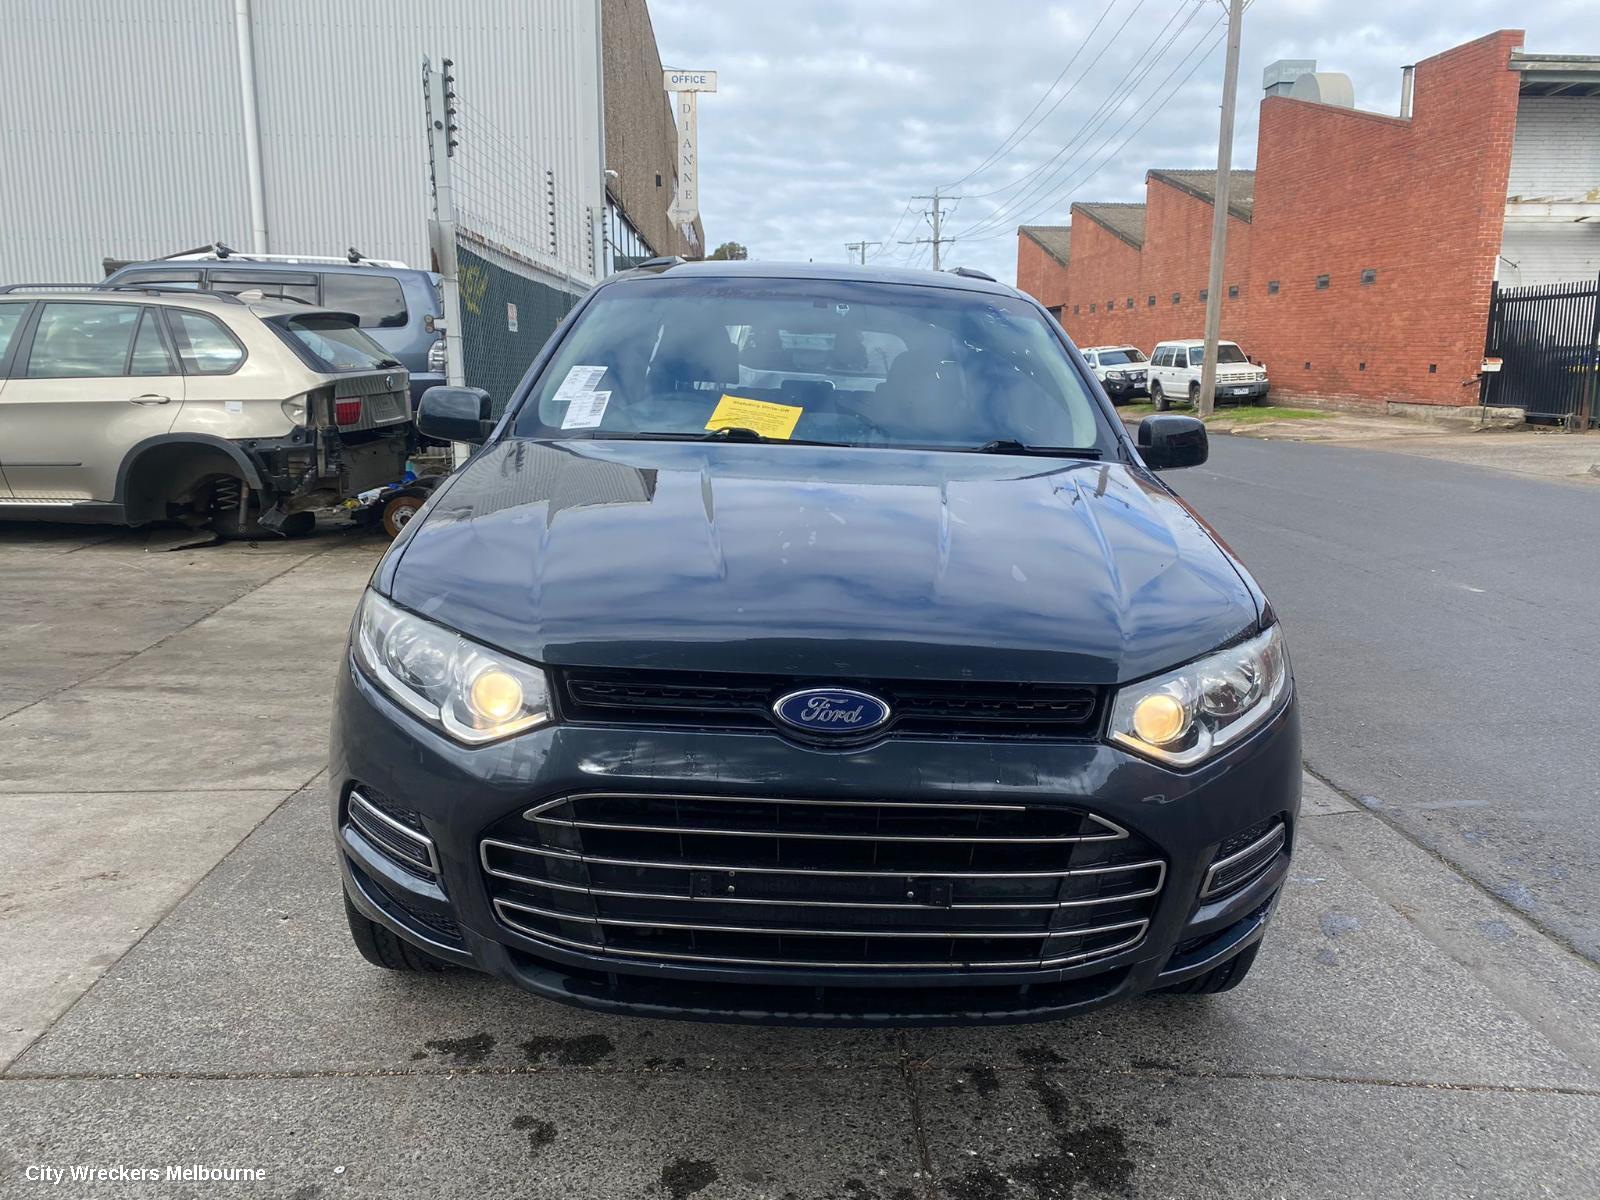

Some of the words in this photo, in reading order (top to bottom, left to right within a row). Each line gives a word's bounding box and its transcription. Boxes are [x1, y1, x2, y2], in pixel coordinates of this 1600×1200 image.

[671, 75, 706, 84] OFFICE
[682, 103, 693, 200] DIANNE
[800, 696, 864, 723] Ford
